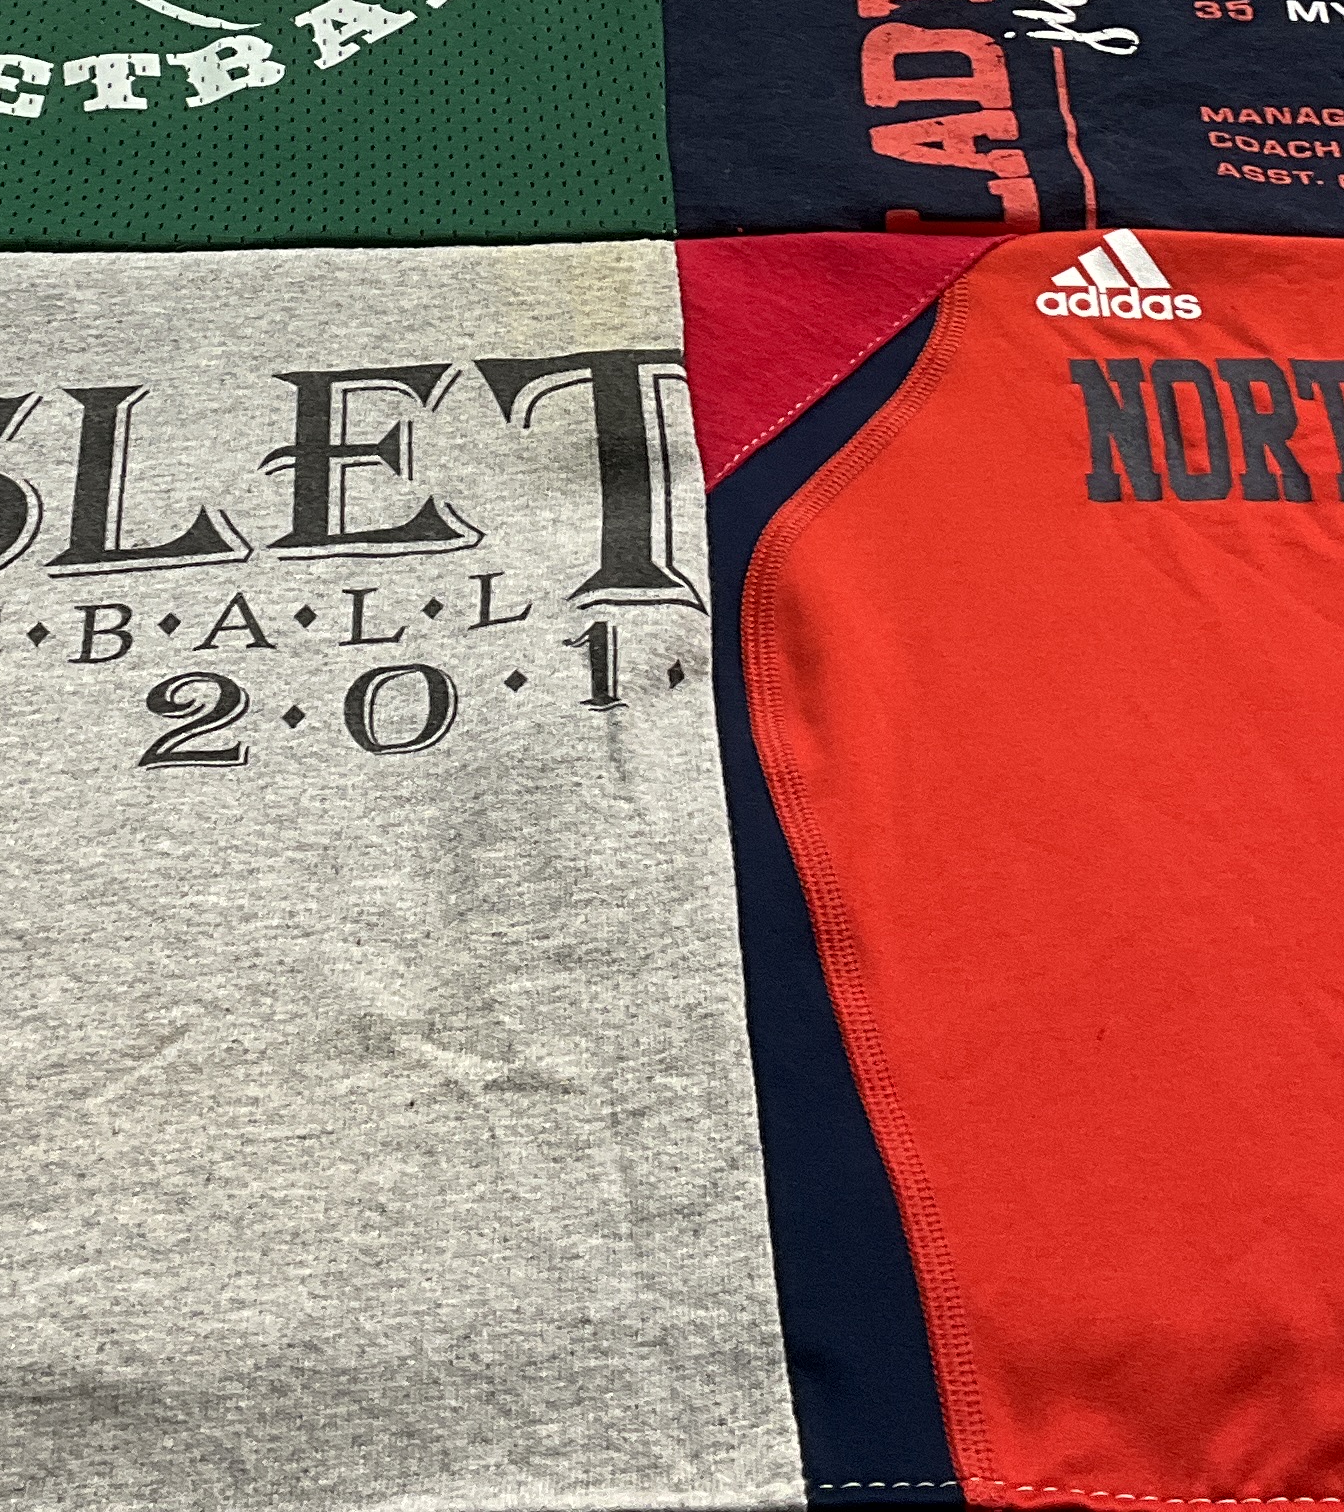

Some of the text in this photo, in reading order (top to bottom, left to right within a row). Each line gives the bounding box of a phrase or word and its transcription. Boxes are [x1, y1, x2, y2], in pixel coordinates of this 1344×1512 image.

[1207, 130, 1342, 160] COACH
[1216, 161, 1325, 186] ASST.
[1034, 286, 1204, 322] adidas
